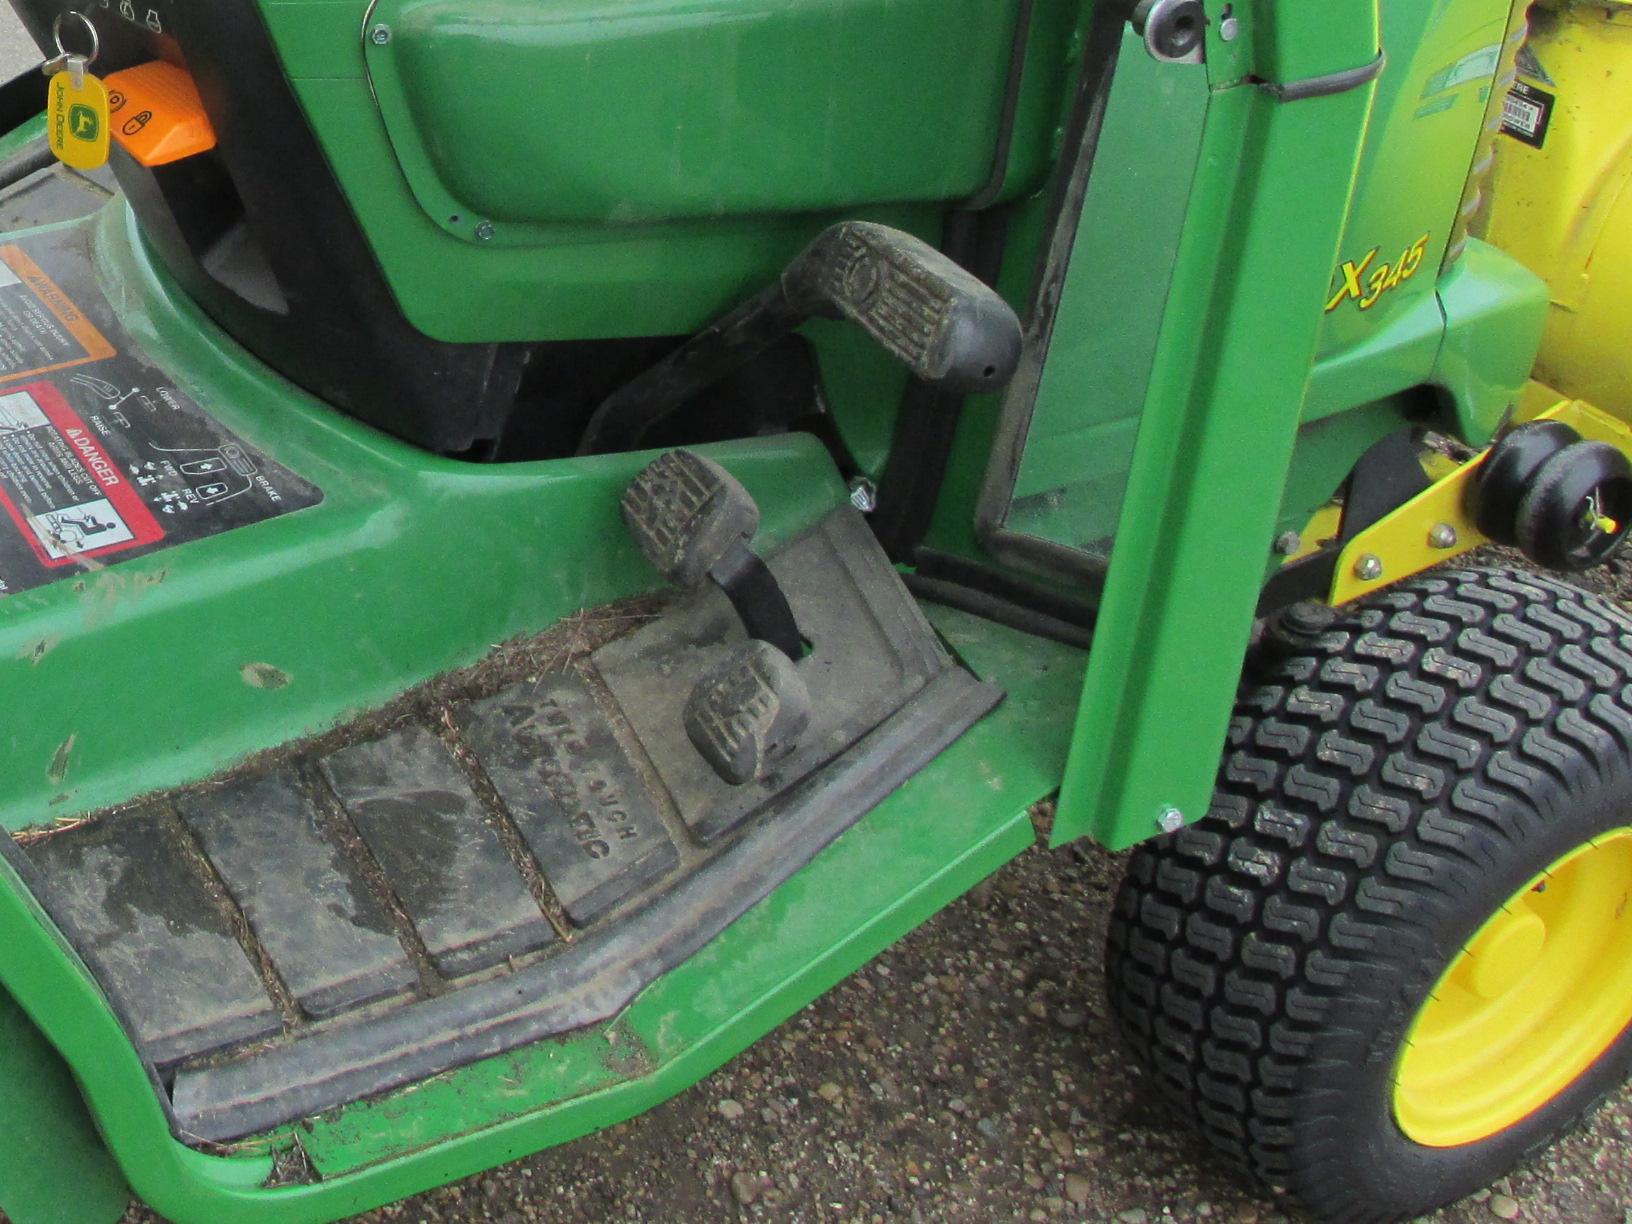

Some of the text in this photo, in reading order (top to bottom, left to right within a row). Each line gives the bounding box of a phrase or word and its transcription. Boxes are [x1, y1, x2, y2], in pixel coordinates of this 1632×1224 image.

[55, 81, 65, 150] JOHN DEERE
[39, 280, 80, 322] WARNING
[156, 387, 179, 409] LOWER
[90, 415, 109, 435] RAISE
[73, 437, 120, 486] DANGER
[160, 460, 177, 476] FWD
[182, 488, 199, 504] REV
[255, 475, 280, 501] BRAKE
